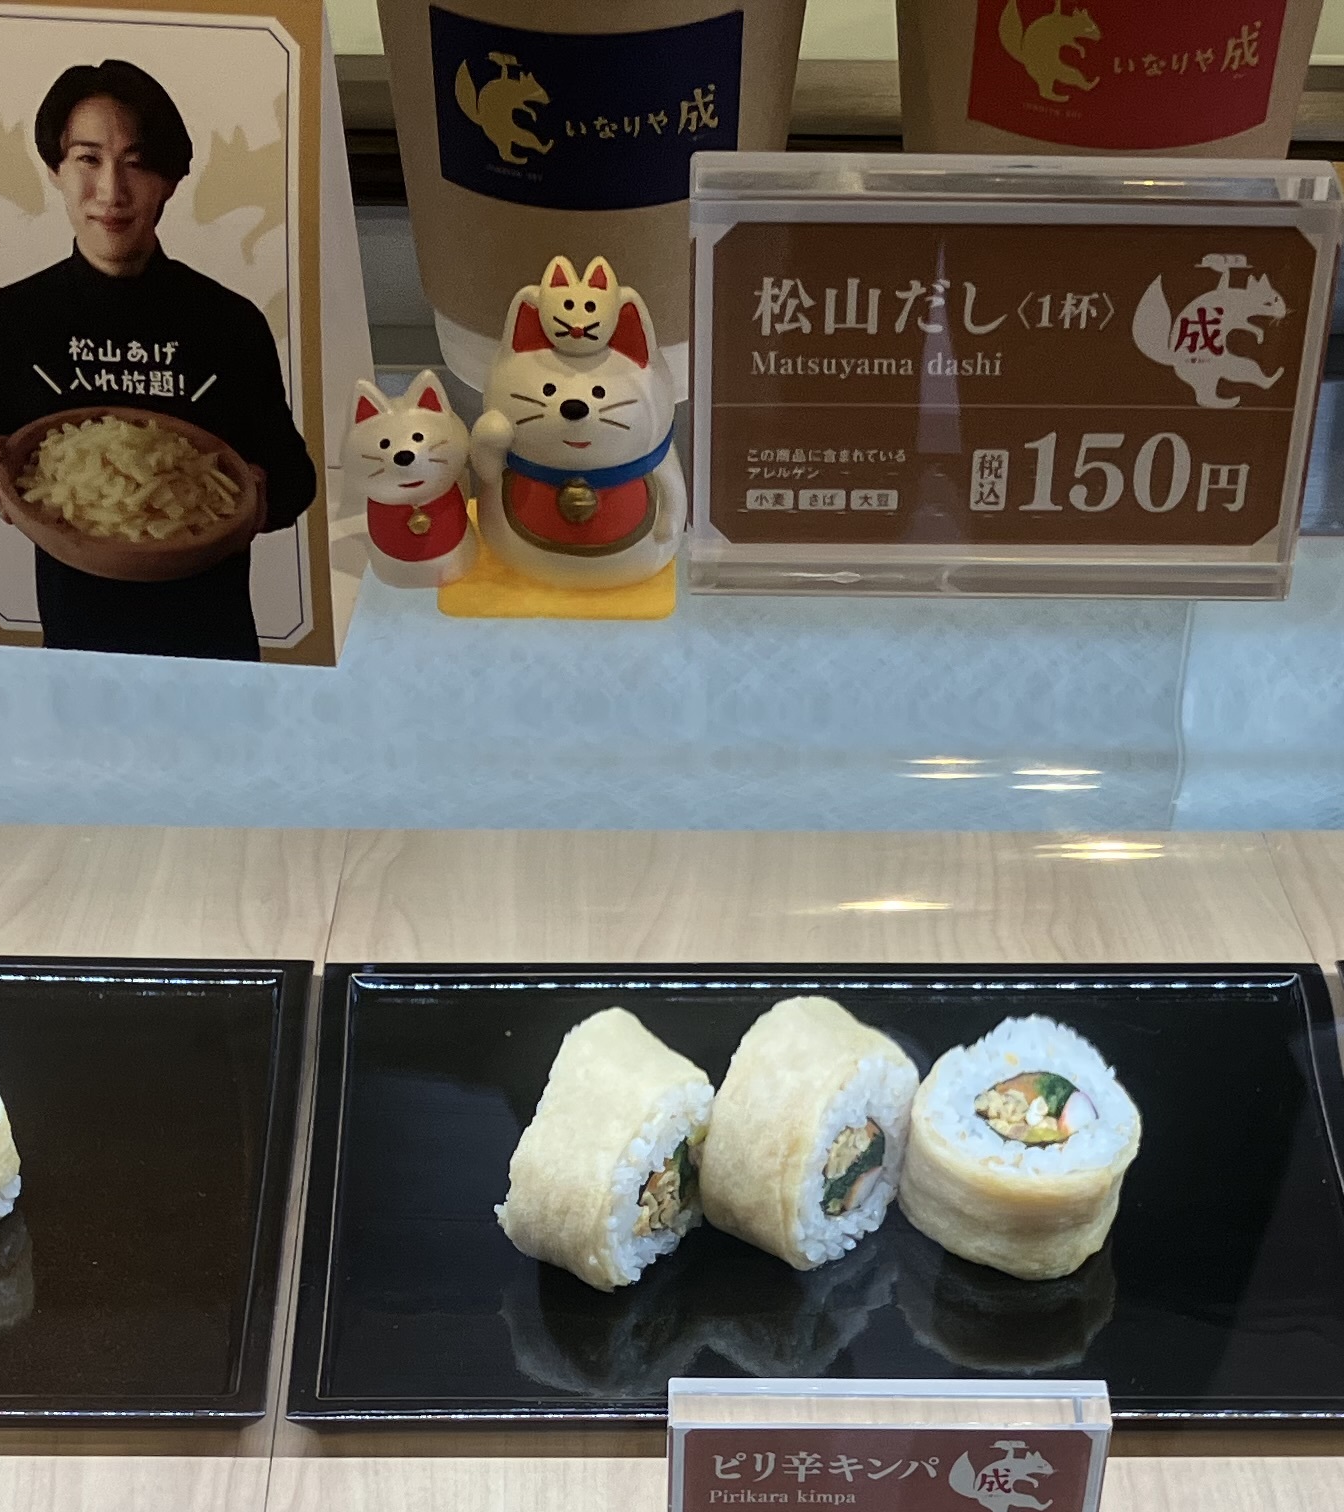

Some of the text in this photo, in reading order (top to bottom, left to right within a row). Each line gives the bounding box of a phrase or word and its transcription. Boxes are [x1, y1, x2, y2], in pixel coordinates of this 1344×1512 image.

[1113, 20, 1262, 77] いなりや成
[565, 83, 719, 139] いなりや成
[1174, 307, 1225, 357] 成
[68, 336, 179, 365] 松山あげ
[750, 350, 1003, 379] Matsuyama dashi
[973, 431, 1250, 513] 税込 150円
[712, 1451, 940, 1482] ピリ辛キンパ
[977, 1468, 1013, 1494] 成
[709, 1489, 856, 1506] Pirikara kimpa
